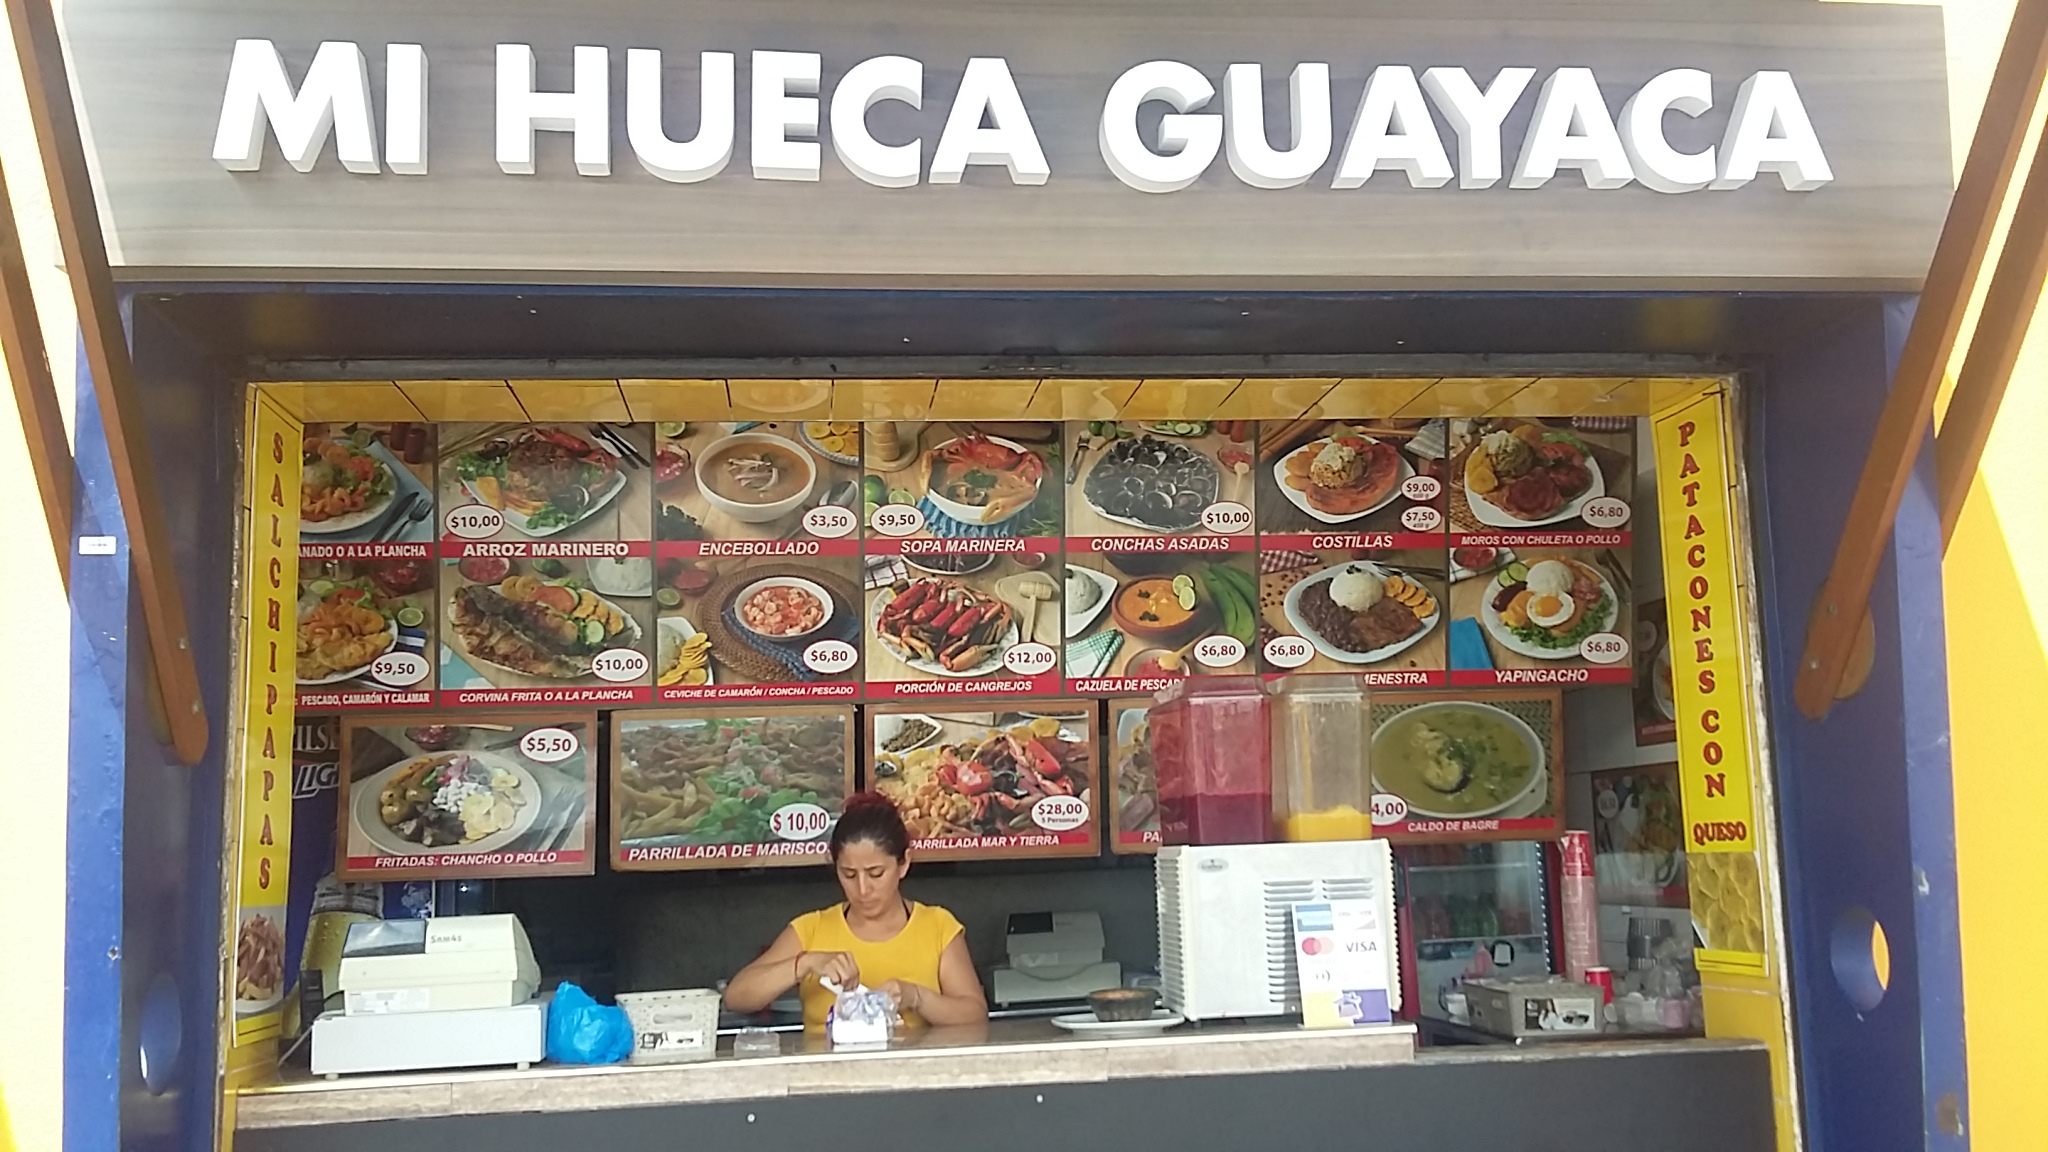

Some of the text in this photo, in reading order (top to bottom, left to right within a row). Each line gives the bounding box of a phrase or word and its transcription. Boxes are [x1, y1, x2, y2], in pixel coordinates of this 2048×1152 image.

[211, 38, 1836, 194] MI HUECA GUAYACA
[1406, 483, 1435, 493] $9,00
[1206, 512, 1250, 525] $10,00
[1406, 512, 1435, 522] $7,50
[1589, 506, 1623, 518] $6,80
[451, 515, 500, 529] $10,00
[810, 514, 848, 528] $3,50
[879, 514, 916, 527] $9,50
[900, 539, 1026, 553] SOPA MARINERA
[1091, 537, 1230, 551] CONCHAS ASADAS
[1312, 535, 1394, 549] COSTILLAS
[1461, 534, 1621, 546] MOROS CON CHULETA O POLLO
[336, 545, 345, 557] O
[347, 545, 356, 557] A
[358, 545, 373, 557] LA
[375, 545, 427, 557] PLANCHA
[463, 542, 629, 557] ARROZ MARINERO
[698, 541, 820, 556] ENCEBOLLADO
[1679, 420, 1728, 798] PATACONES CON
[1200, 645, 1237, 657] $6,80
[1269, 644, 1306, 657] $6,80
[1586, 641, 1621, 653] $6,80
[257, 431, 284, 890] SALCHIPAPAS
[810, 650, 848, 663] $6,80
[1007, 652, 1052, 664] $12,00
[374, 662, 416, 676] $9,50
[595, 658, 643, 671] $10,00
[1494, 669, 1589, 683] YAPINGACHO
[664, 689, 703, 698] CEVICHE
[704, 689, 716, 698] DE
[718, 685, 763, 698] CAMARÓN
[768, 687, 807, 696] CONCHA
[812, 686, 854, 696] PESCADO
[894, 680, 1033, 694] PORCIÓN DE CANGREJOS
[1075, 678, 1186, 692] CAZUELA DE PESCA
[302, 691, 430, 706] PESCADO, CAMARÓN Y CALAMAR
[459, 690, 634, 703] CORVINA FRITA O A LA PLANCHA
[525, 736, 572, 755] $5,50
[1038, 803, 1083, 816] $28,00
[1047, 816, 1079, 824] Personas
[1407, 820, 1500, 832] CALDO DE BAGRE
[980, 835, 1006, 848] MAR
[1008, 835, 1017, 846] Y
[1019, 834, 1059, 847] TIERRA
[1693, 821, 1747, 847] QUESO
[628, 841, 830, 862] PARRILLADA DE MARISCO
[375, 852, 558, 868] FRITADAS: CHANCHO O POLLO
[1346, 941, 1377, 953] VISA
